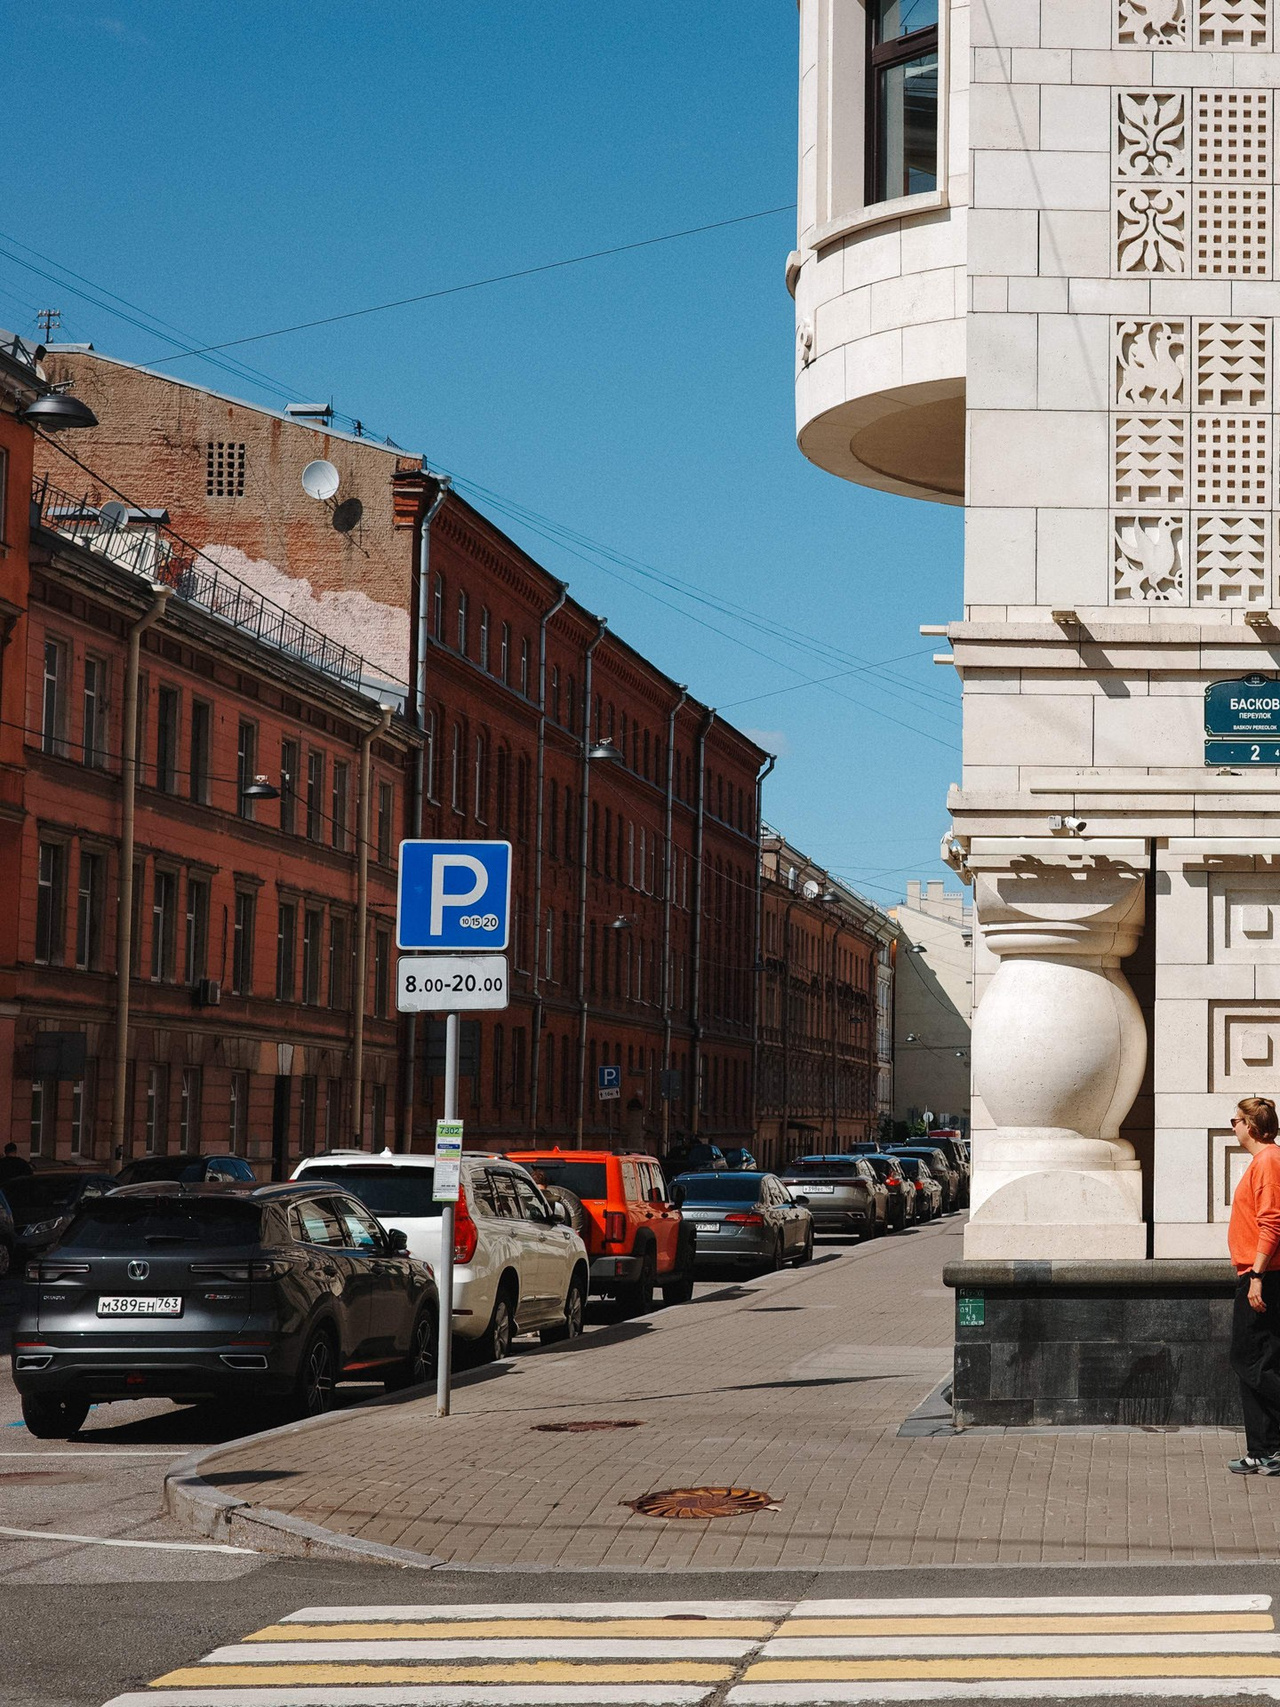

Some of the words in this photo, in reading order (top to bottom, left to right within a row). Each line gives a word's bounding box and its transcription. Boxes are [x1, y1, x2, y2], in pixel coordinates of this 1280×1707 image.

[1230, 698, 1280, 710] БАСКОВ
[1250, 745, 1260, 760] 2
[430, 854, 489, 936] P
[461, 917, 469, 925] 10
[471, 916, 481, 927] 15
[483, 917, 497, 927] 20
[405, 974, 503, 993] 8.00-20.00
[604, 1069, 616, 1085] P
[440, 1127, 460, 1135] 7302
[158, 1298, 178, 1308] 763
